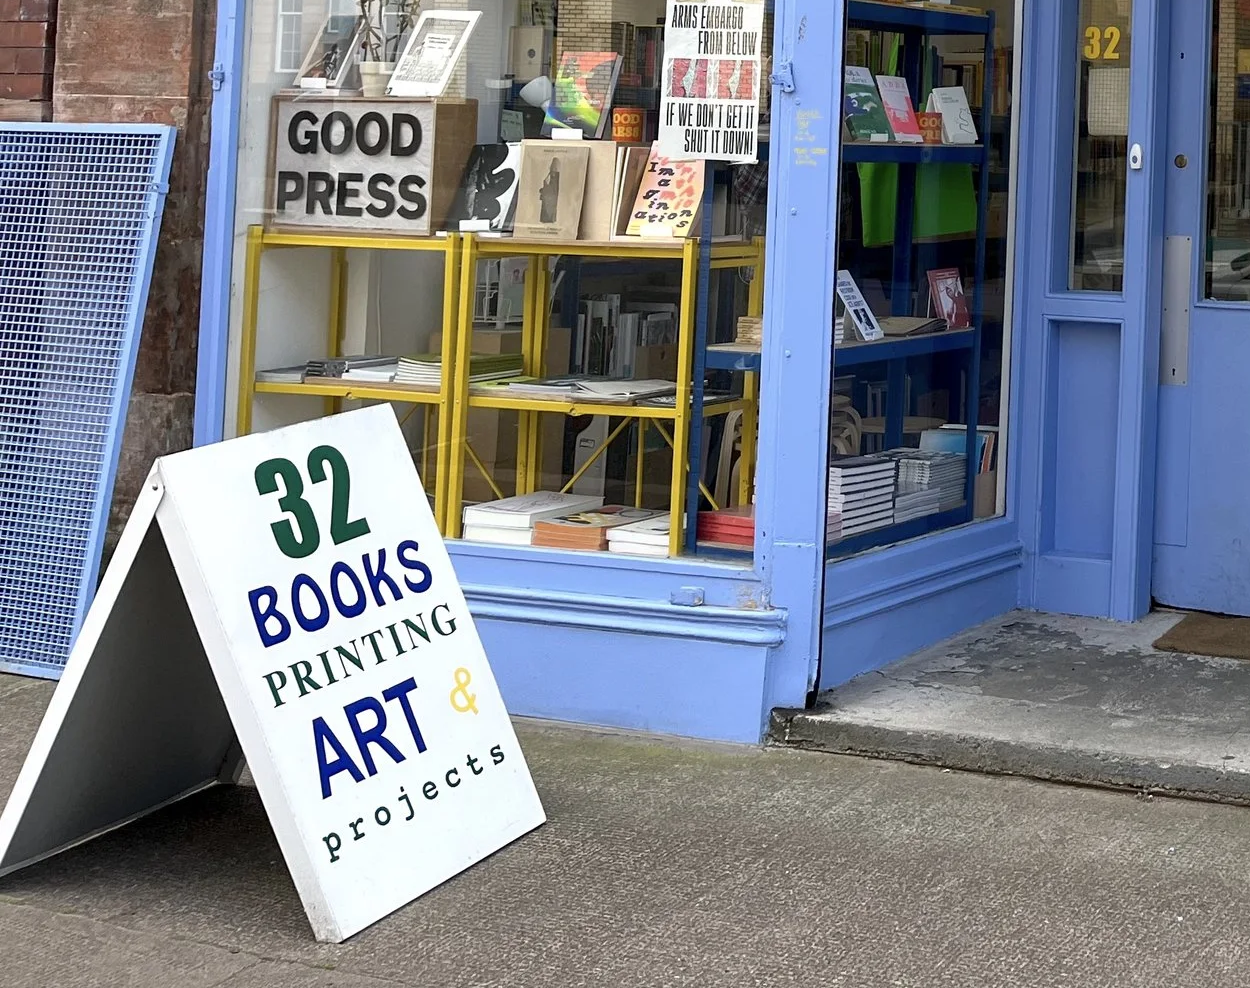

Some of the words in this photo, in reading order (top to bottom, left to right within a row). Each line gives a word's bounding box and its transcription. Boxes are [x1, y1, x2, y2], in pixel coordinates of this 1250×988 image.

[671, 5, 698, 29] ARMS
[701, 5, 744, 30] EMBARGO
[698, 31, 723, 55] FROM
[726, 31, 757, 55] BELOW
[1084, 26, 1121, 61] 32
[287, 110, 423, 157] GOOD
[666, 102, 676, 127] IF
[678, 103, 694, 128] WE
[697, 104, 724, 129] DON'T
[726, 104, 744, 129] GET
[745, 105, 755, 130] IT
[684, 129, 709, 154] SHUT
[711, 129, 720, 154] IT
[723, 130, 753, 155] DOWN!
[277, 170, 428, 220] PRESS
[253, 443, 371, 560] 32
[248, 539, 434, 648] BOOKS
[262, 602, 458, 709] PRINTING
[312, 677, 428, 800] ART
[449, 667, 479, 715] &
[322, 743, 506, 863] projects
